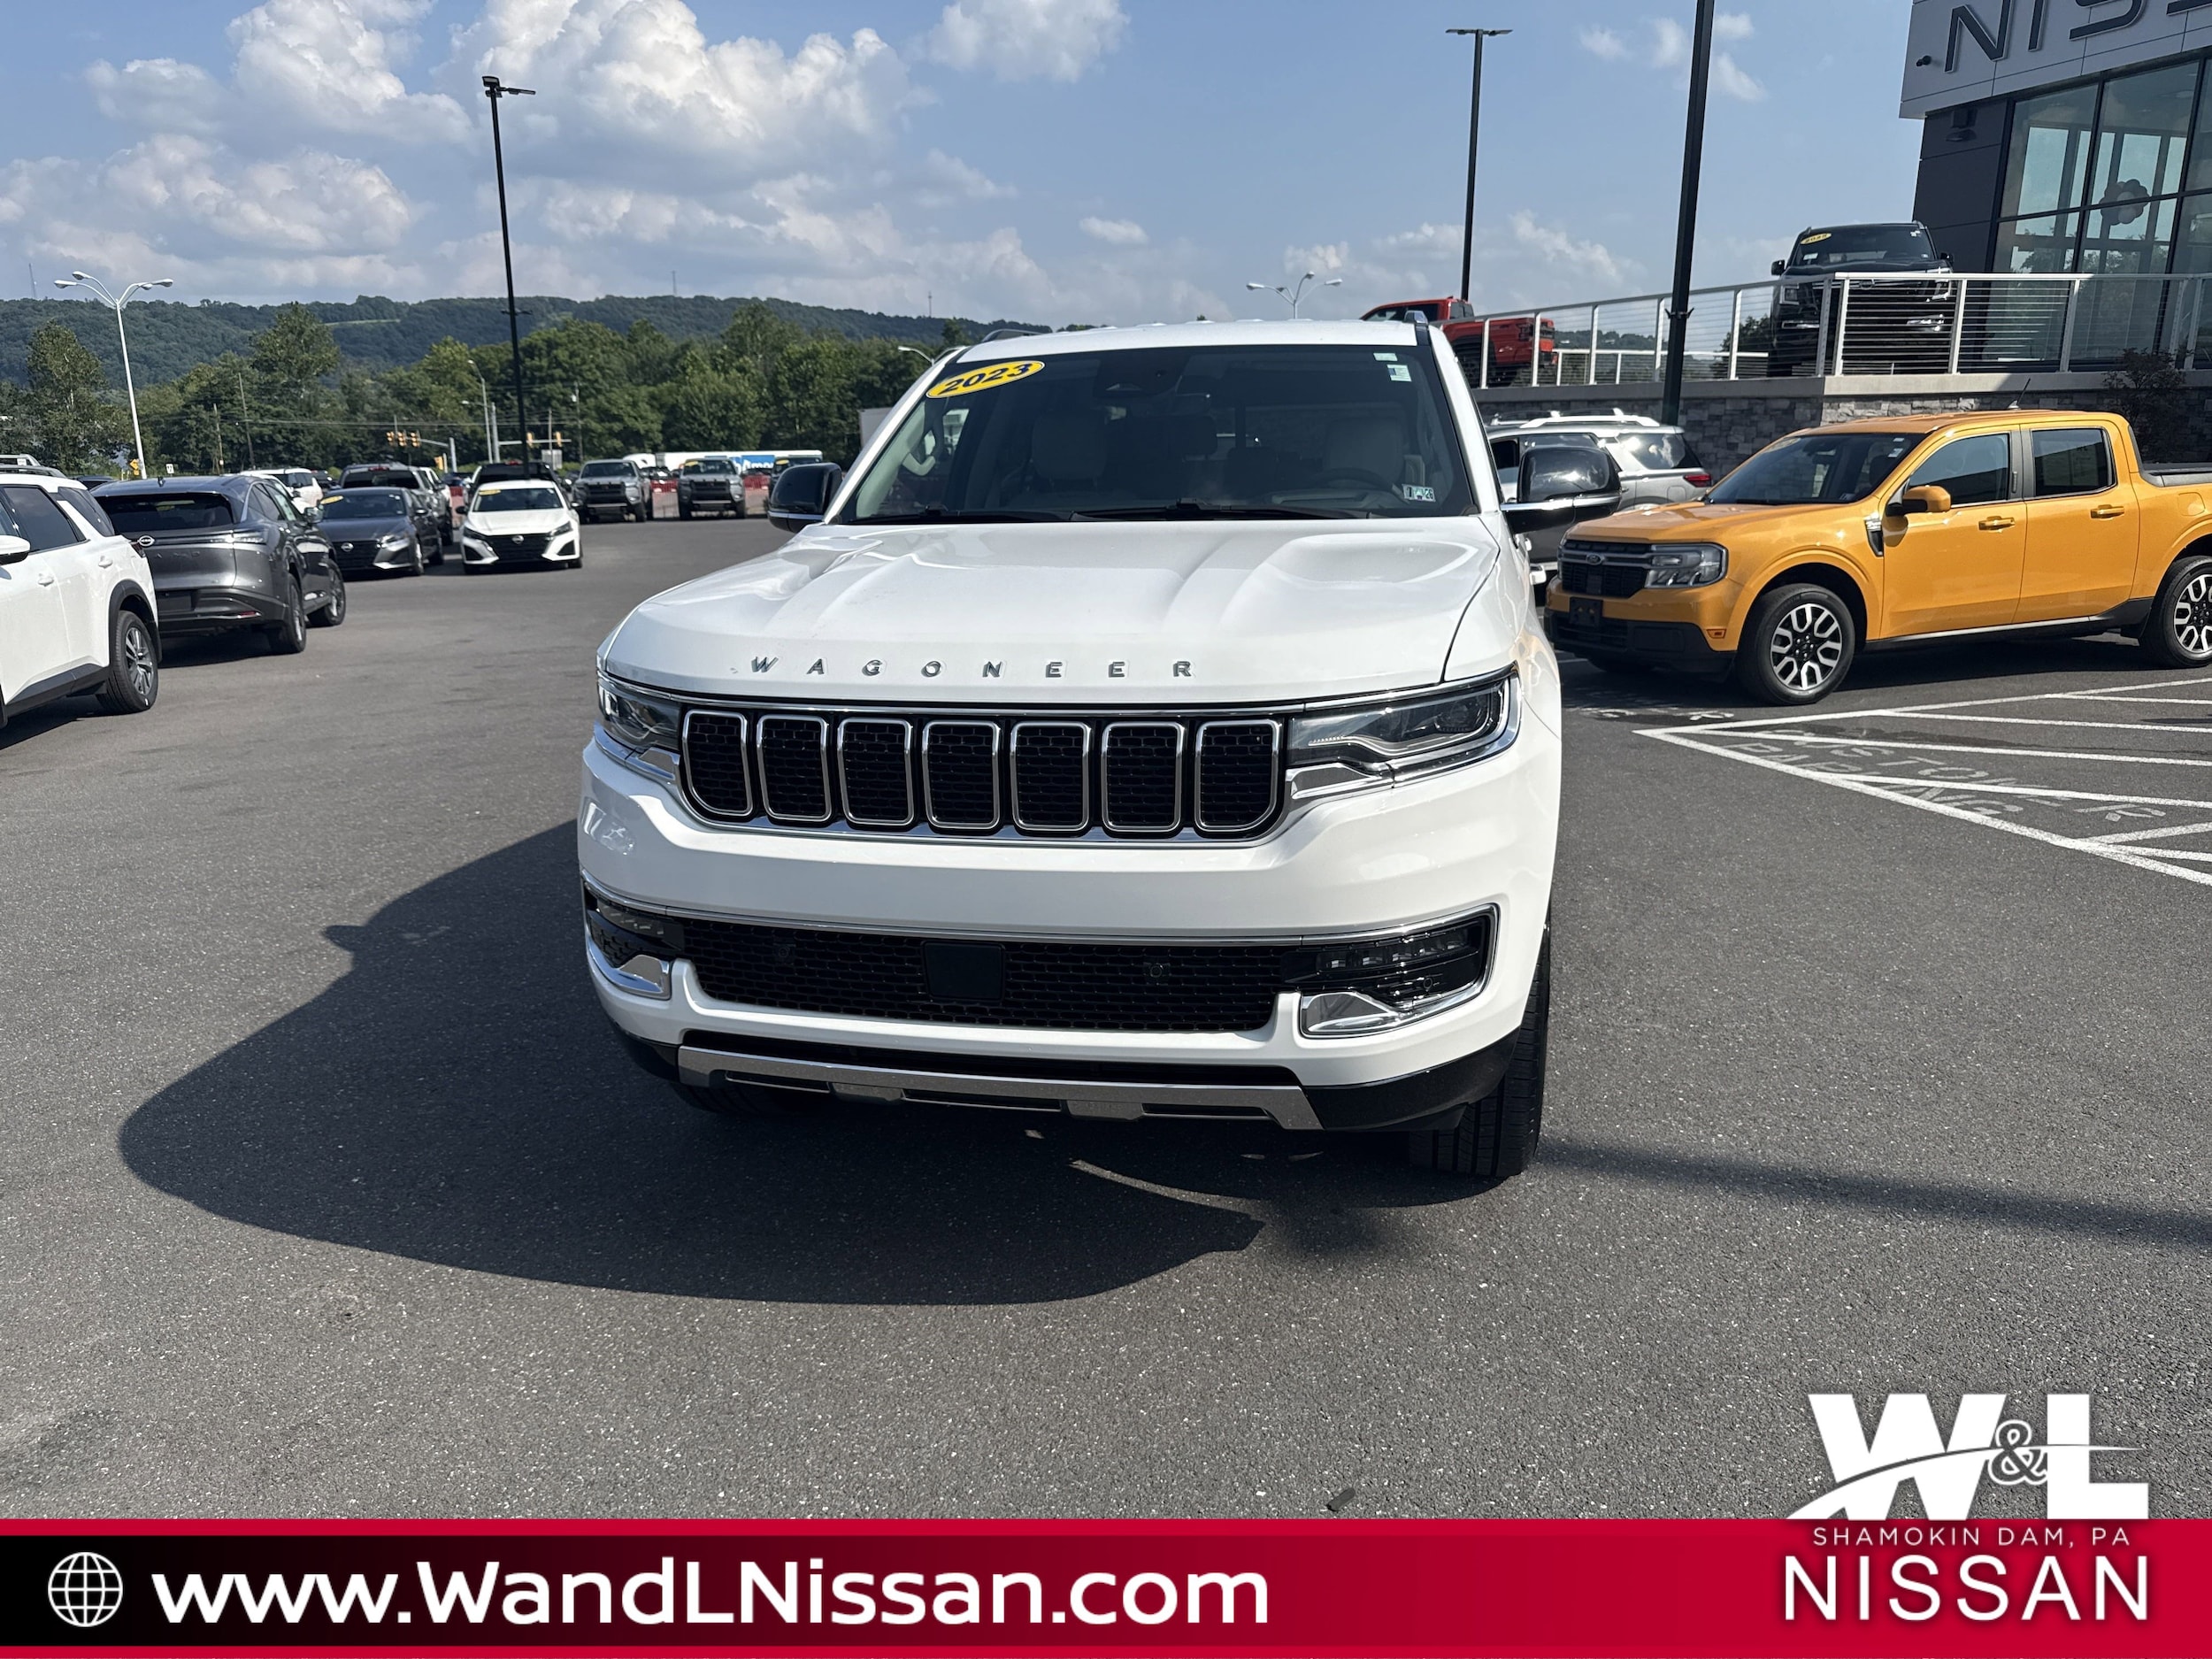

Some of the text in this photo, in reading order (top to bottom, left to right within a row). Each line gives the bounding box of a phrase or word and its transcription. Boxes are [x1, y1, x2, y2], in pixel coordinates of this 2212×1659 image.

[1944, 0, 2212, 73] NIS
[937, 363, 1033, 396] 2023
[750, 656, 1192, 678] WAGONEER
